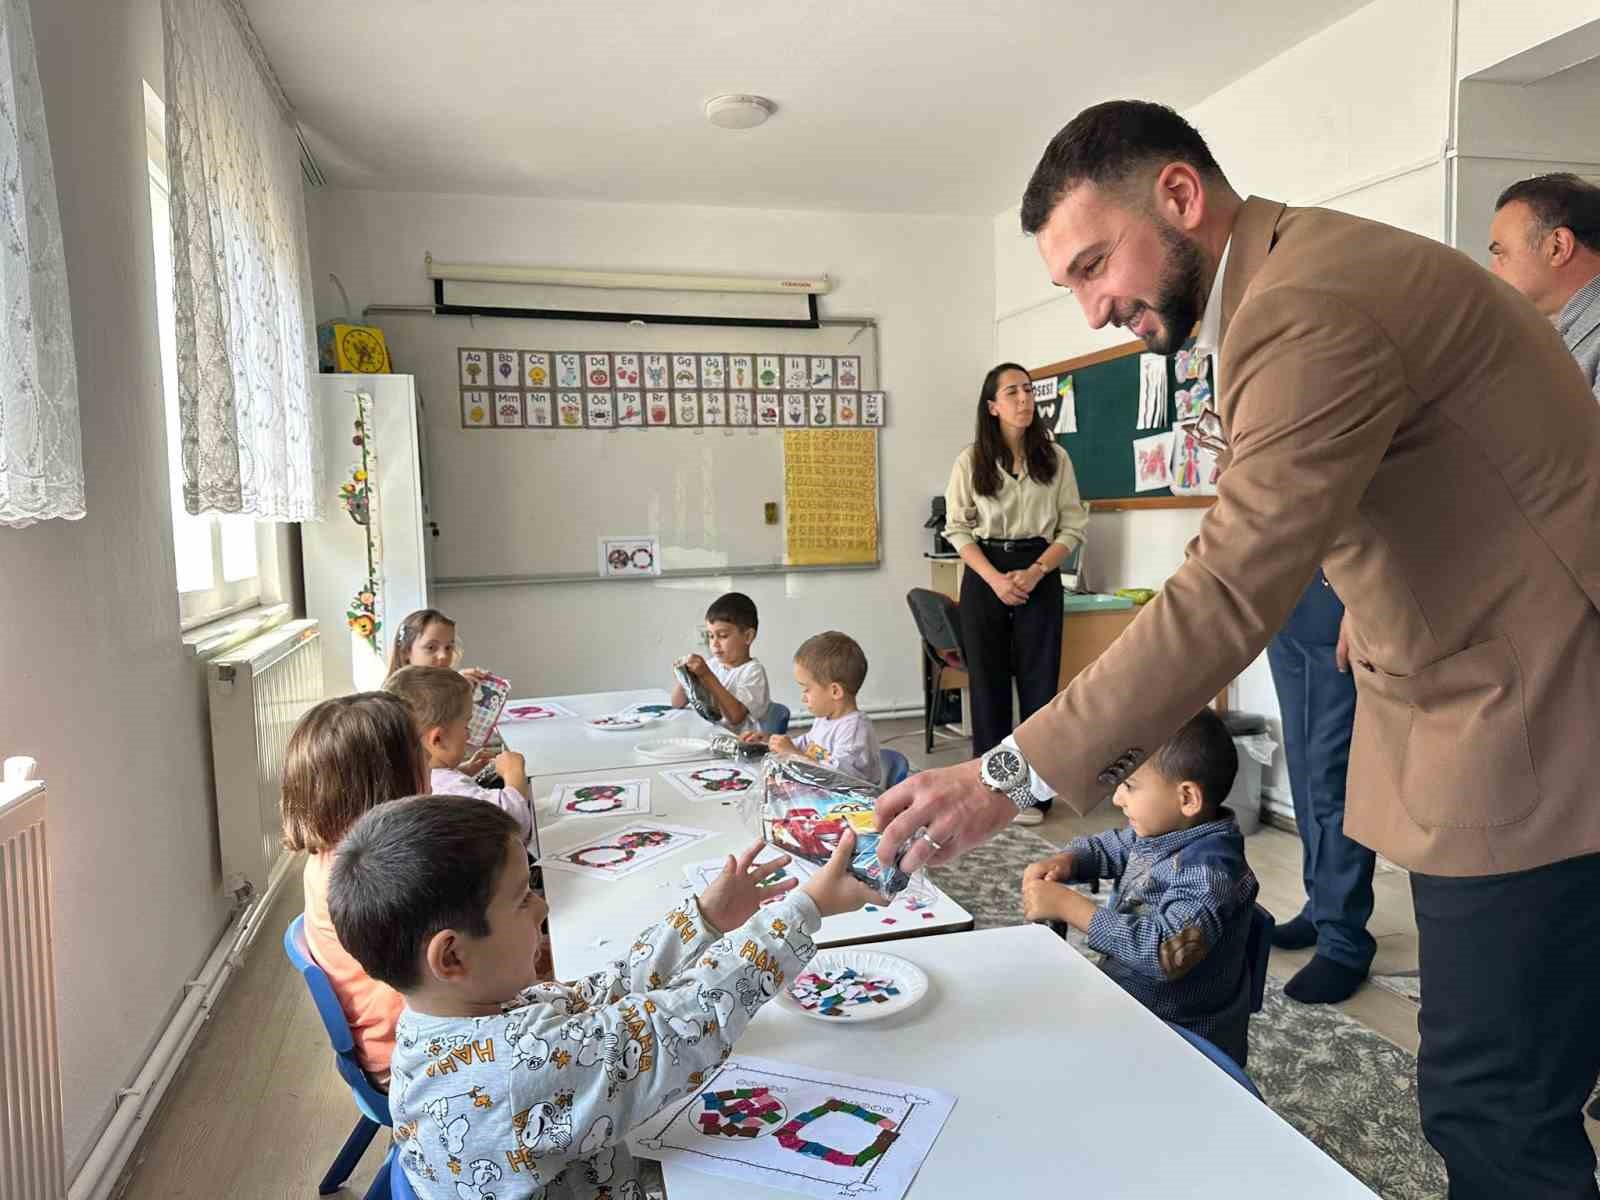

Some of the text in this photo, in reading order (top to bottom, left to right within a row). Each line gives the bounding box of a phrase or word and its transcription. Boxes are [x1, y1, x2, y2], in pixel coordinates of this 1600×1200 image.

[466, 353, 480, 362] Aa
[498, 353, 512, 362] Bb
[529, 354, 544, 364] Cc
[561, 355, 575, 365] Çç
[591, 357, 605, 366] Dd
[621, 356, 633, 365] Ee
[650, 356, 660, 365] Ff
[678, 356, 691, 367] Gg
[705, 357, 719, 368] Ğğ
[734, 359, 747, 367] Hh
[816, 360, 825, 369] Jj
[842, 360, 854, 368] Kk
[471, 393, 481, 402] Ll
[498, 394, 518, 402] Mm
[531, 394, 546, 402] Nn
[561, 394, 576, 403] Oo
[592, 395, 607, 405] Öö
[623, 393, 636, 403] Pp
[652, 393, 663, 402] Rr
[681, 393, 692, 402] Ss
[708, 393, 719, 403] Şş
[736, 395, 745, 403] Tt
[761, 394, 774, 403] Uu
[813, 396, 825, 404] Vv
[840, 396, 852, 405] Yy
[867, 395, 877, 403] Zz
